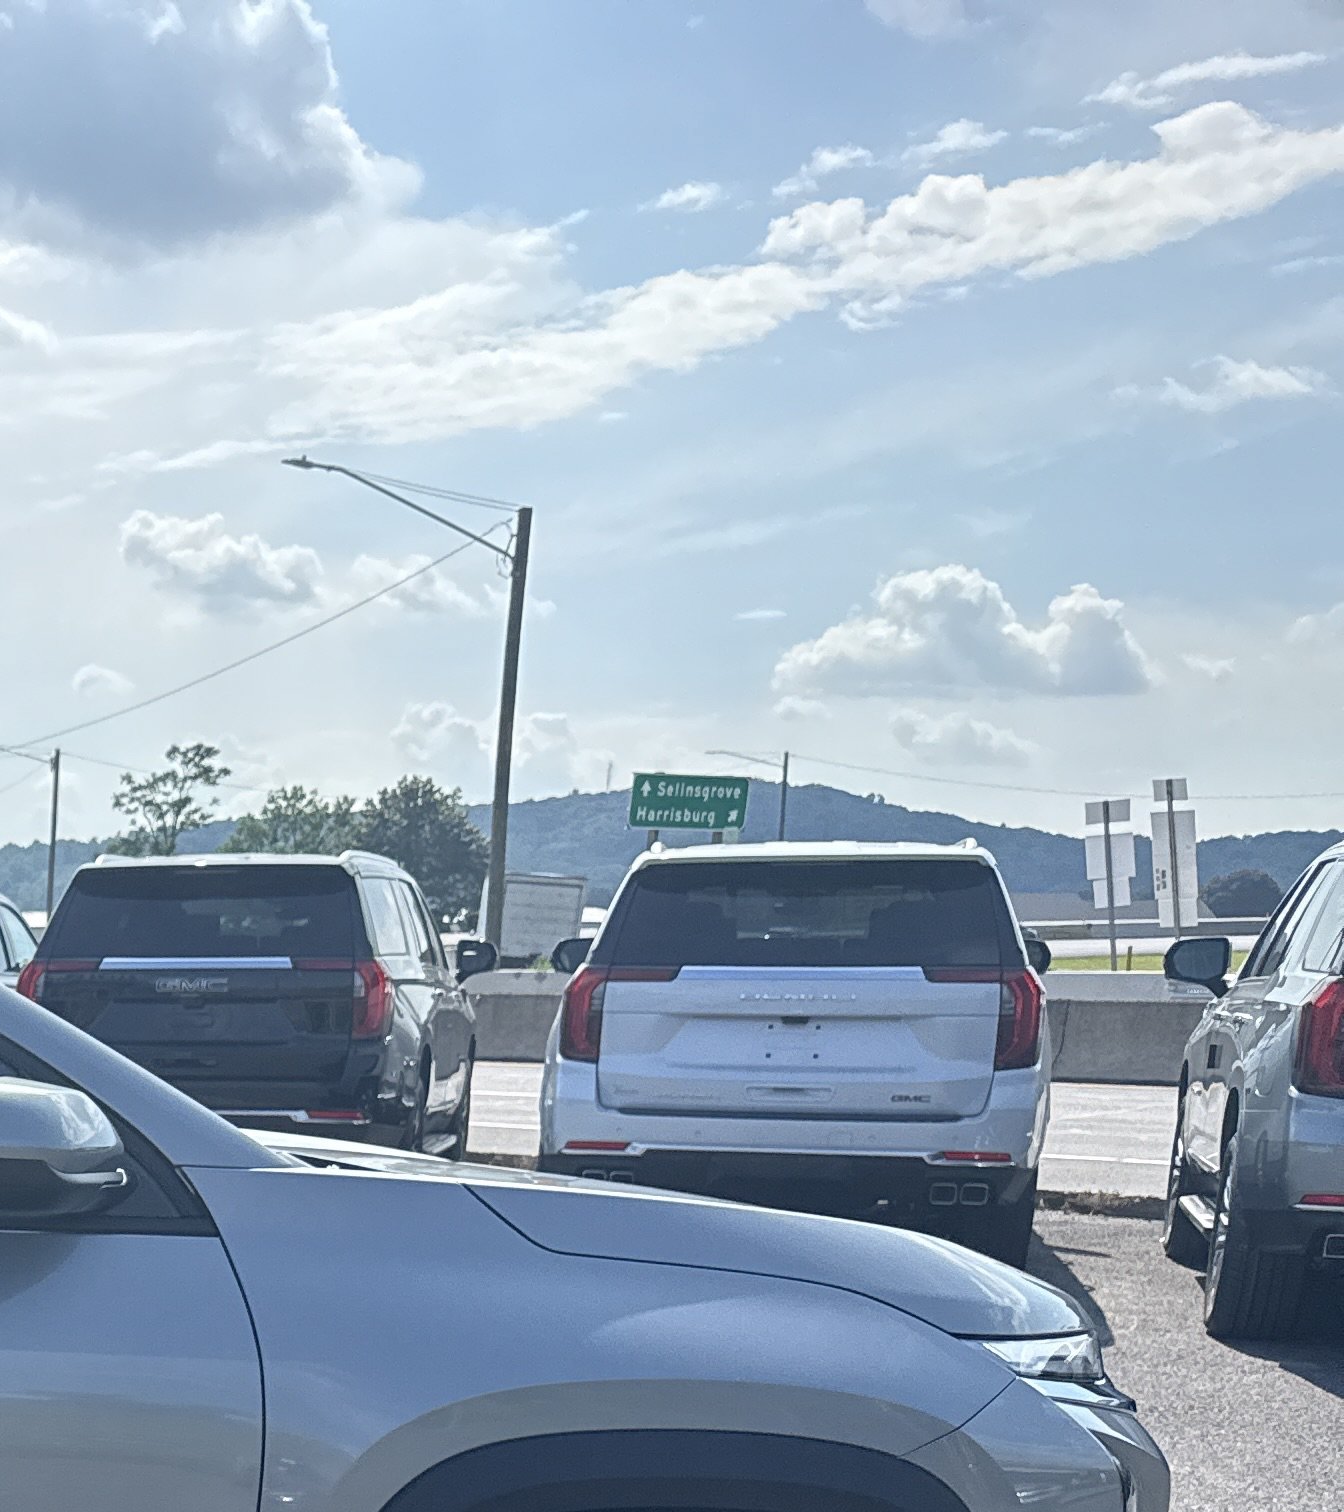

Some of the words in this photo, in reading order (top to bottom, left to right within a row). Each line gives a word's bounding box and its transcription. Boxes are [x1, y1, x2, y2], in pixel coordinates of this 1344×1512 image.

[656, 781, 742, 801] Selinsgrove
[636, 806, 716, 826] Harrisburg
[155, 977, 229, 993] GMC
